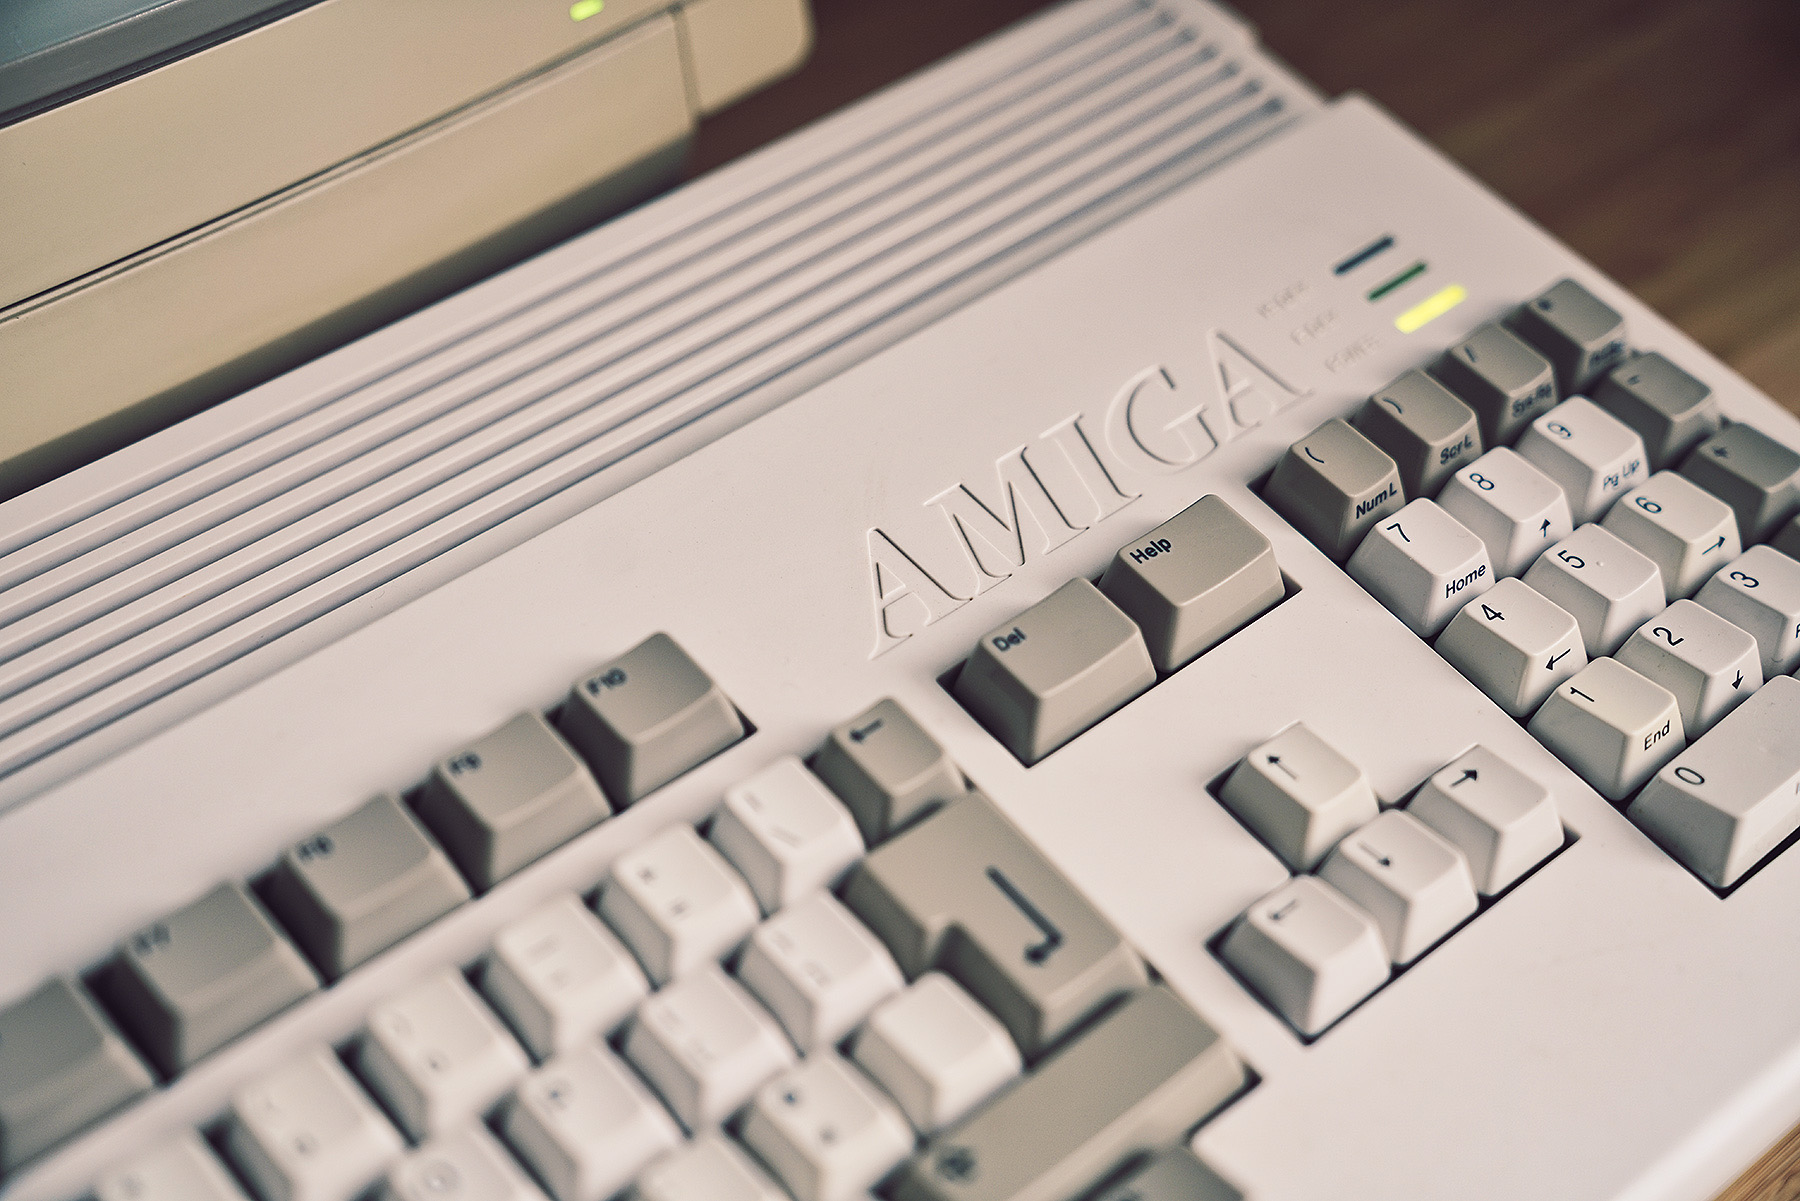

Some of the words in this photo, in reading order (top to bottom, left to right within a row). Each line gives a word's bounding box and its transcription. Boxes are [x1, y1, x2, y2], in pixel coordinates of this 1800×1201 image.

[1547, 420, 1572, 439] 9
[1469, 472, 1495, 491] 8
[1602, 475, 1619, 491] Pg
[1622, 460, 1640, 477] Up
[867, 326, 1315, 660] AMIGA
[1635, 496, 1662, 514] 6
[1386, 522, 1411, 543] 7
[1129, 537, 1173, 565] Help
[1557, 549, 1585, 569] 5
[1445, 564, 1486, 599] Home
[1730, 571, 1760, 589] 3
[1481, 603, 1505, 621] 4
[992, 626, 1027, 653] Del
[1653, 626, 1685, 647] 2
[1570, 686, 1595, 703] 1
[1644, 720, 1671, 751] End
[1674, 766, 1705, 786] 0
